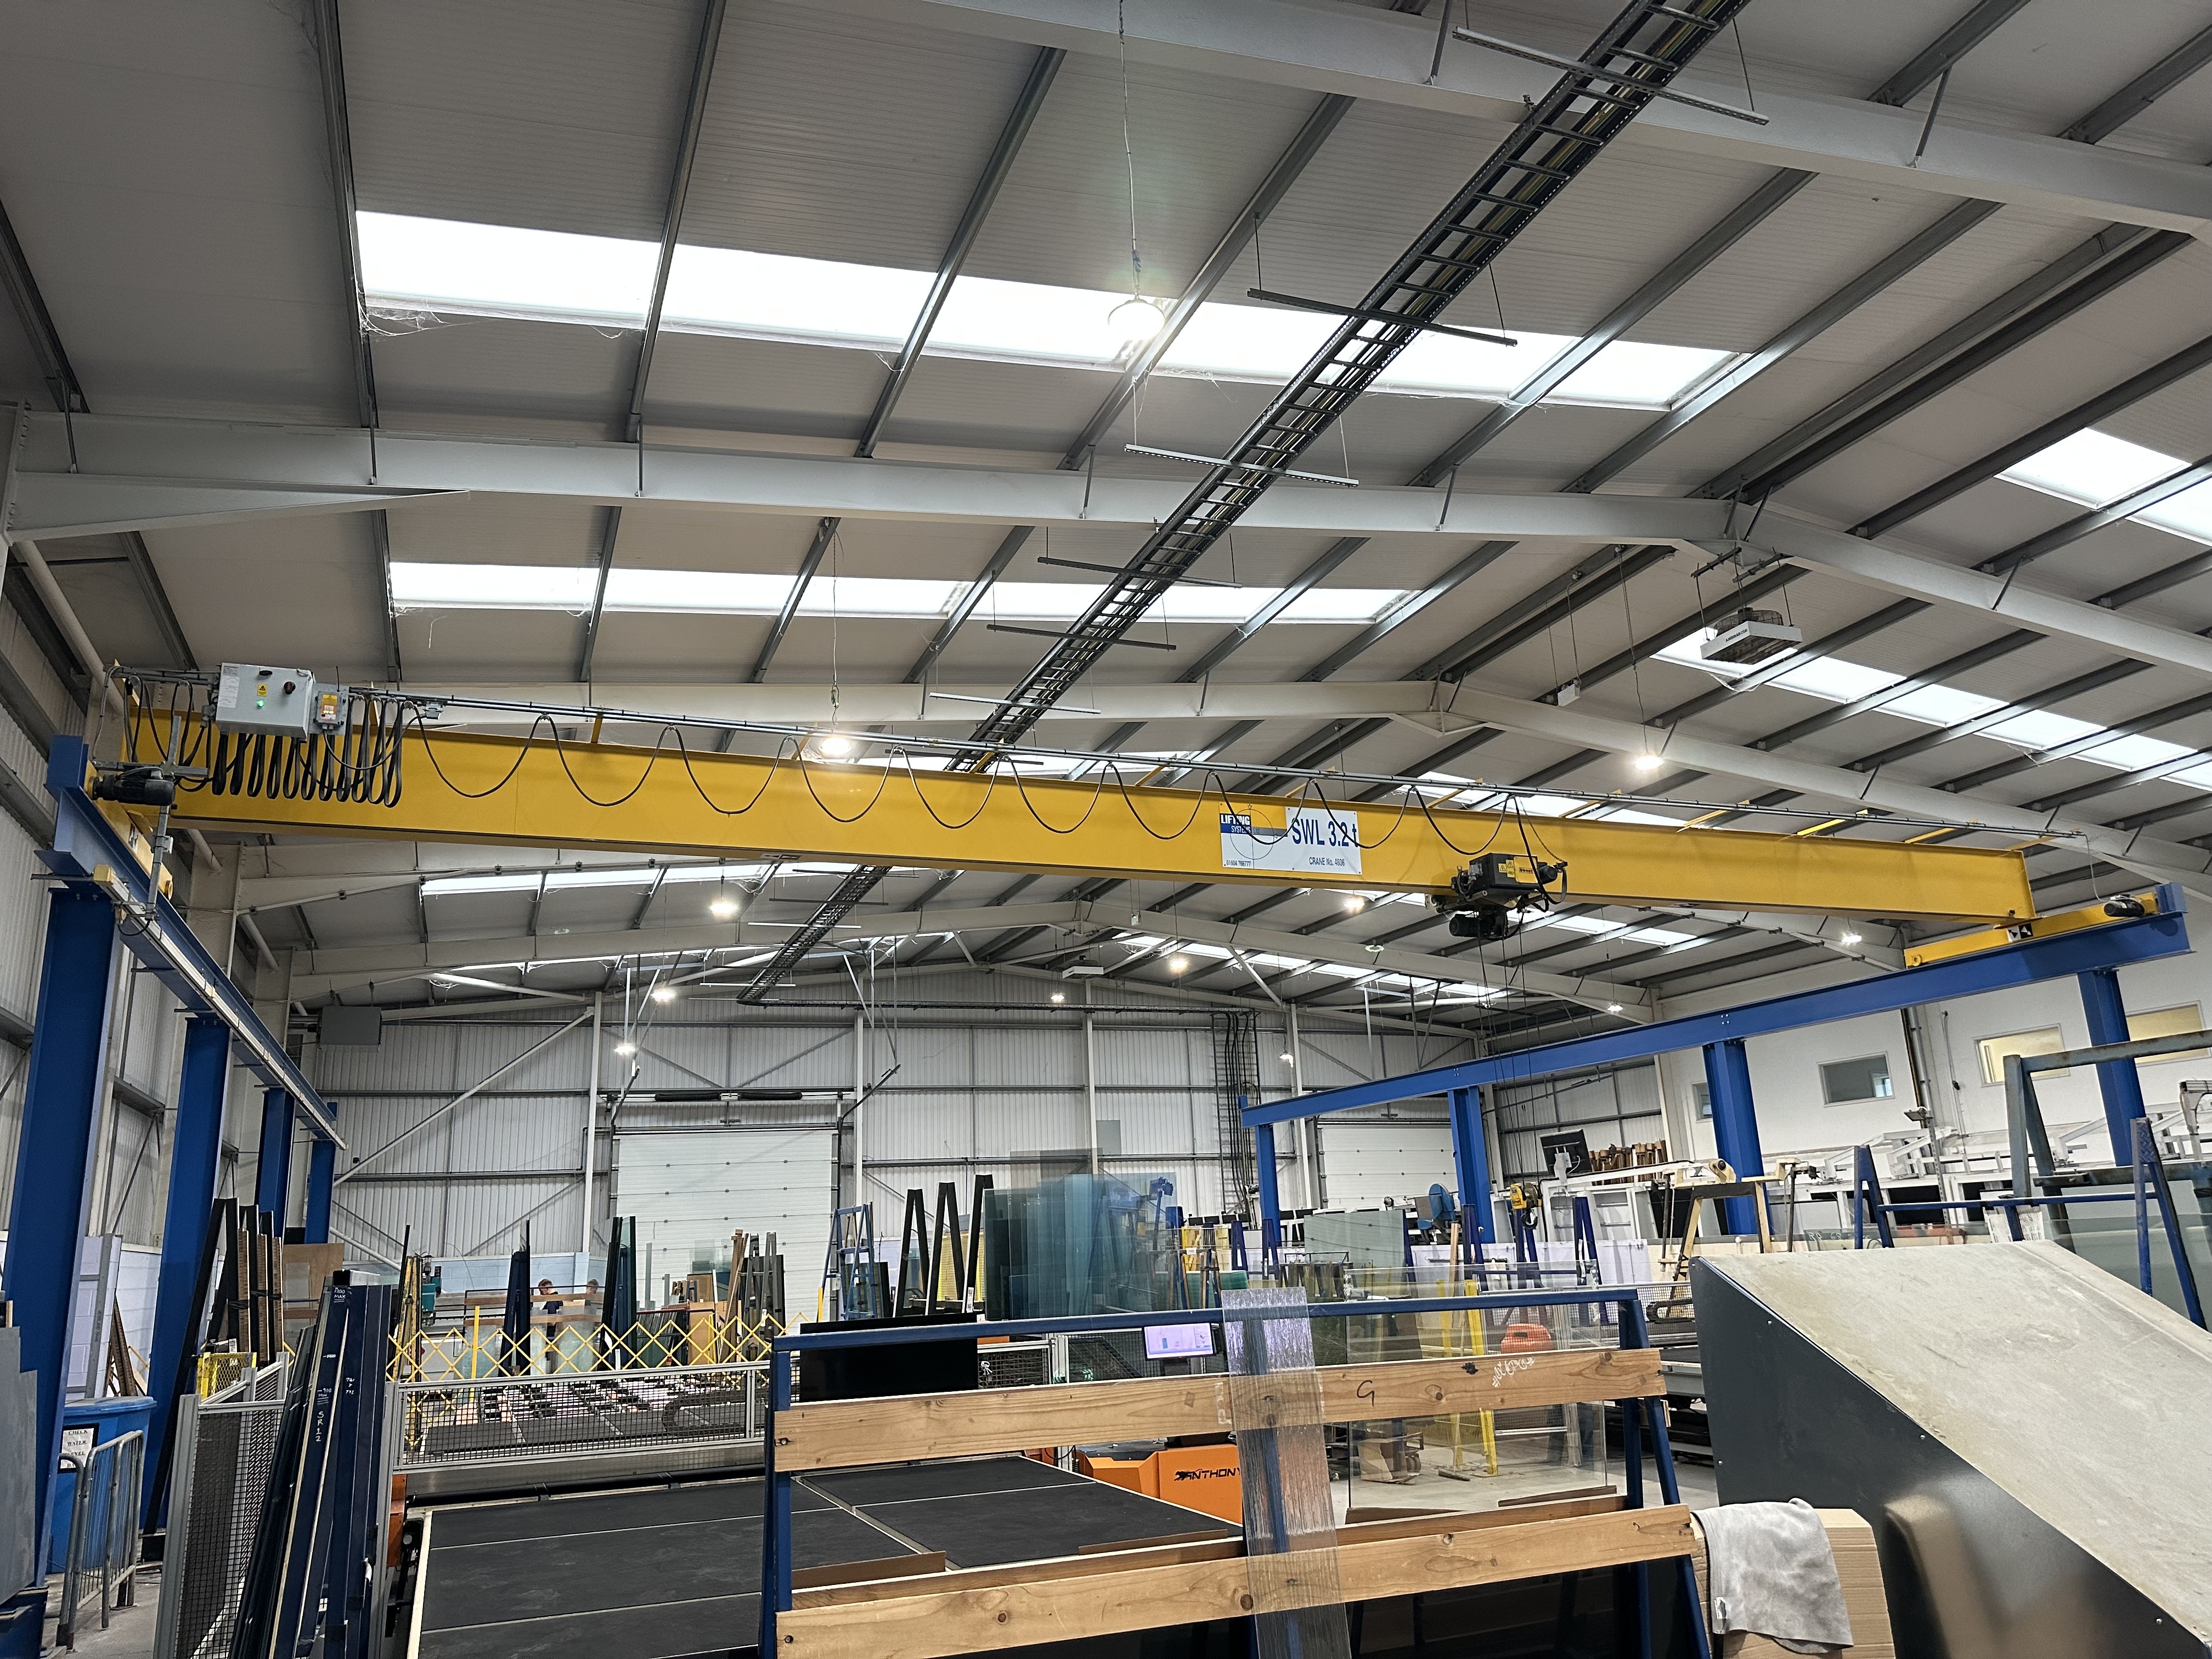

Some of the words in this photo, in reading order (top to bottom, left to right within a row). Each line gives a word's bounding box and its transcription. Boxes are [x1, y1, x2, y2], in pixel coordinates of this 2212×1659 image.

[1291, 817, 1325, 845] SWL
[1328, 821, 1349, 847] 3.2
[1352, 823, 1358, 848] t
[1309, 856, 1325, 865] CRANE
